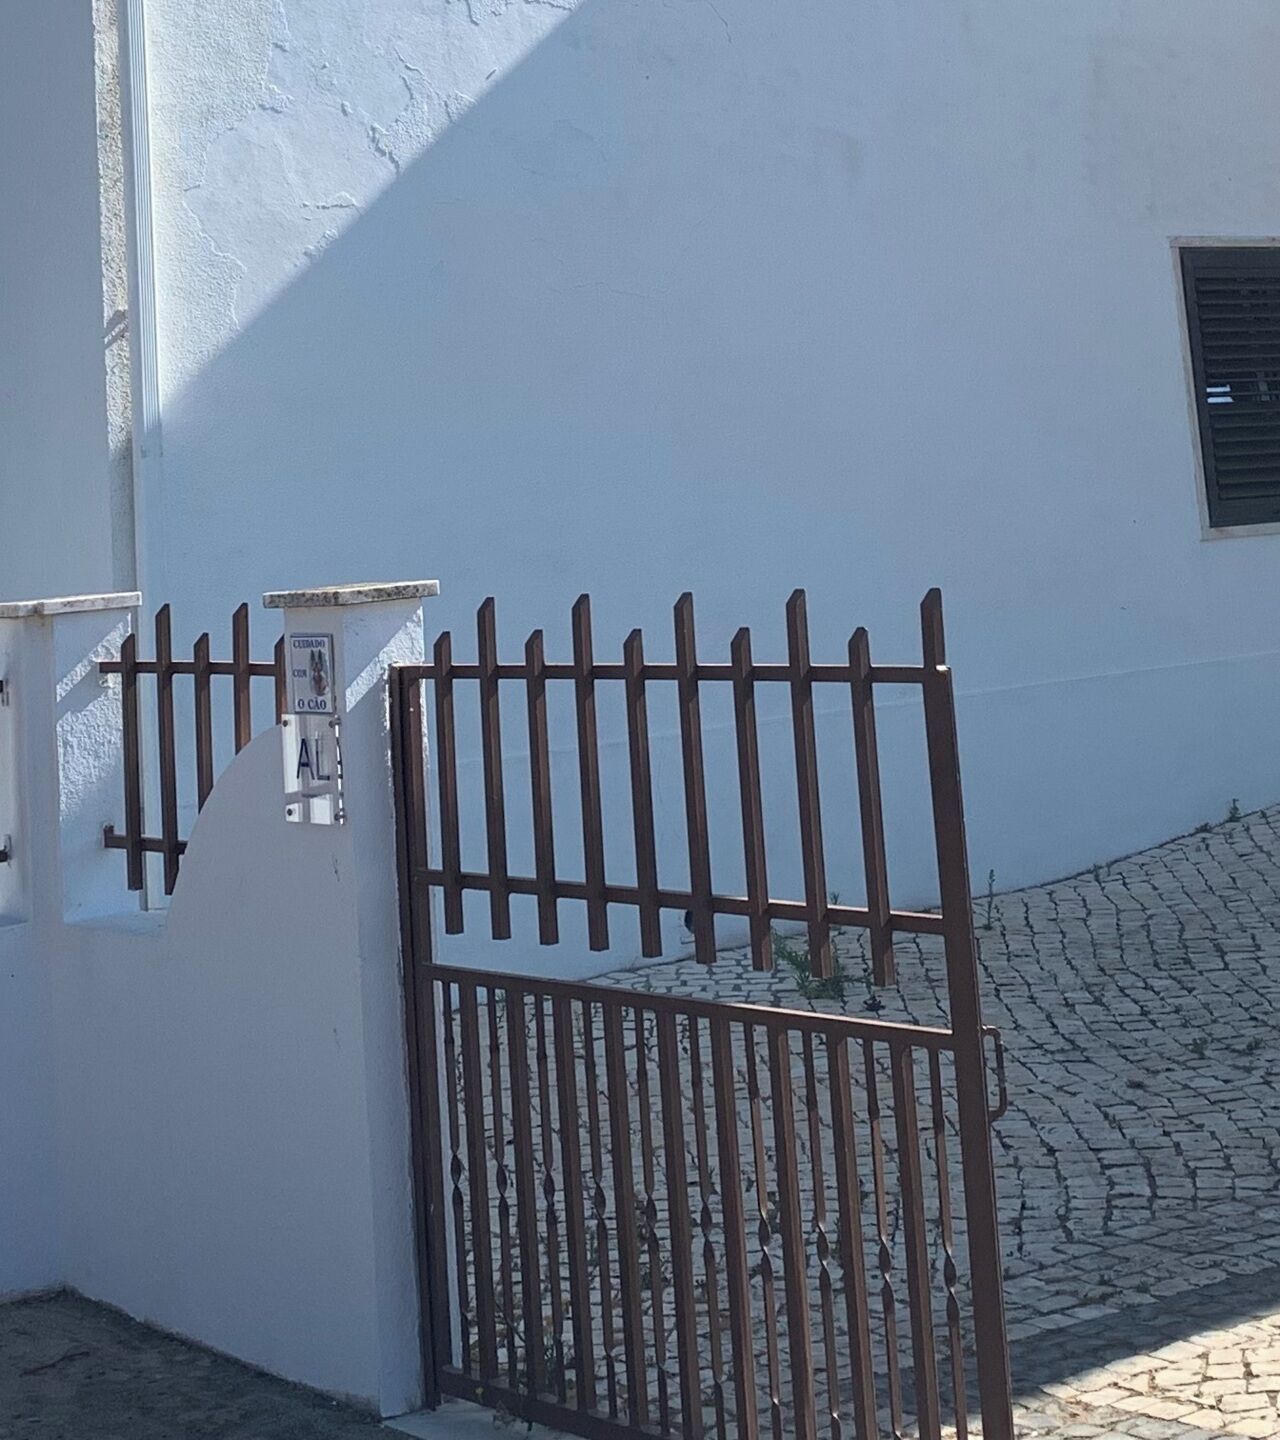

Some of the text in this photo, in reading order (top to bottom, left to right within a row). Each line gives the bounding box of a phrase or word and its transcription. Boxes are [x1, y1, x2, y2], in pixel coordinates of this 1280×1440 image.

[292, 639, 326, 649] CUIDADO
[297, 696, 327, 710] O CÃO
[296, 736, 331, 781] AL
